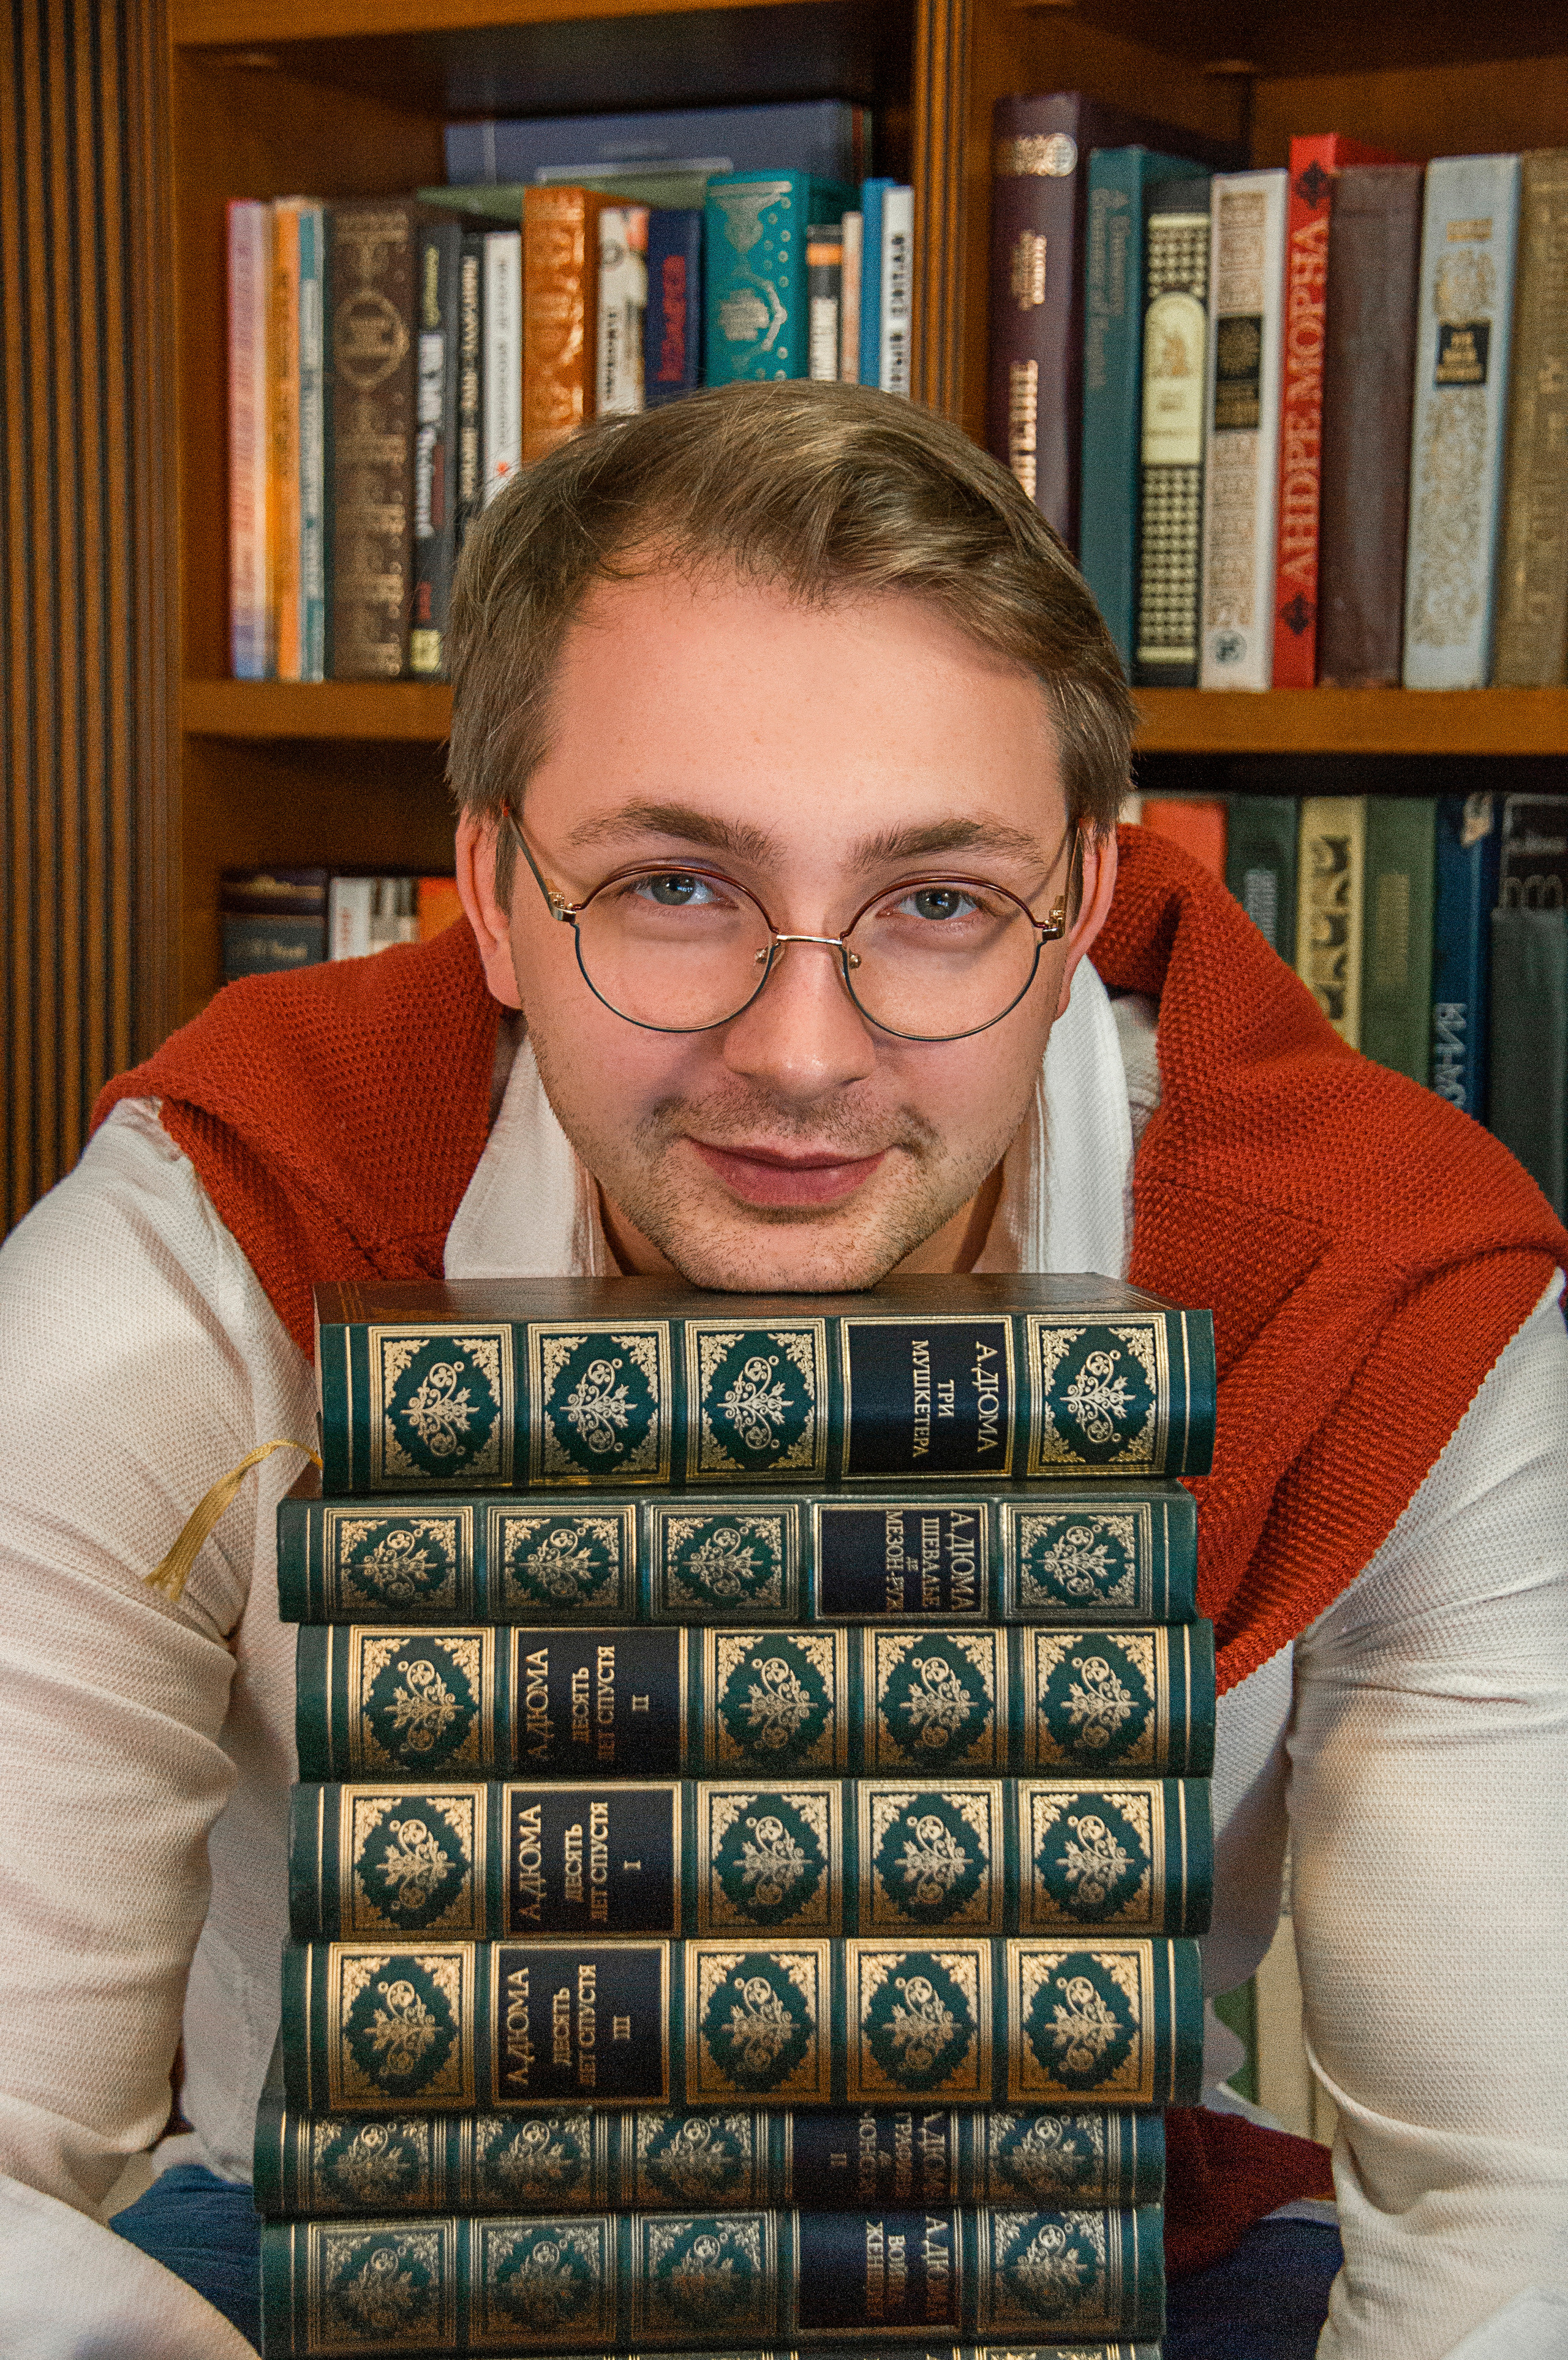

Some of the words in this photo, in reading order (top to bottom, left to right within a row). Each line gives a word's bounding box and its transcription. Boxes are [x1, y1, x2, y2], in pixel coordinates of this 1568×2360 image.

[911, 1339, 931, 1458] МУШКЕТЕРА
[937, 1379, 955, 1419] ТРИ
[921, 1516, 940, 1608] ШЕВАЛЬЕ
[571, 1666, 590, 1744] ДЕСЯТЬ
[597, 1645, 615, 1725] СПУСТЯ
[564, 1823, 585, 1903] ДЕСЯТЬ
[590, 1801, 608, 1884] СПУСТЯ
[590, 1886, 608, 1923] ЛЕТ
[552, 1987, 573, 2067] ДЕСЯТЬ
[578, 1964, 597, 2048] СПУСТЯ
[578, 2049, 597, 2087] ЛЕТ
